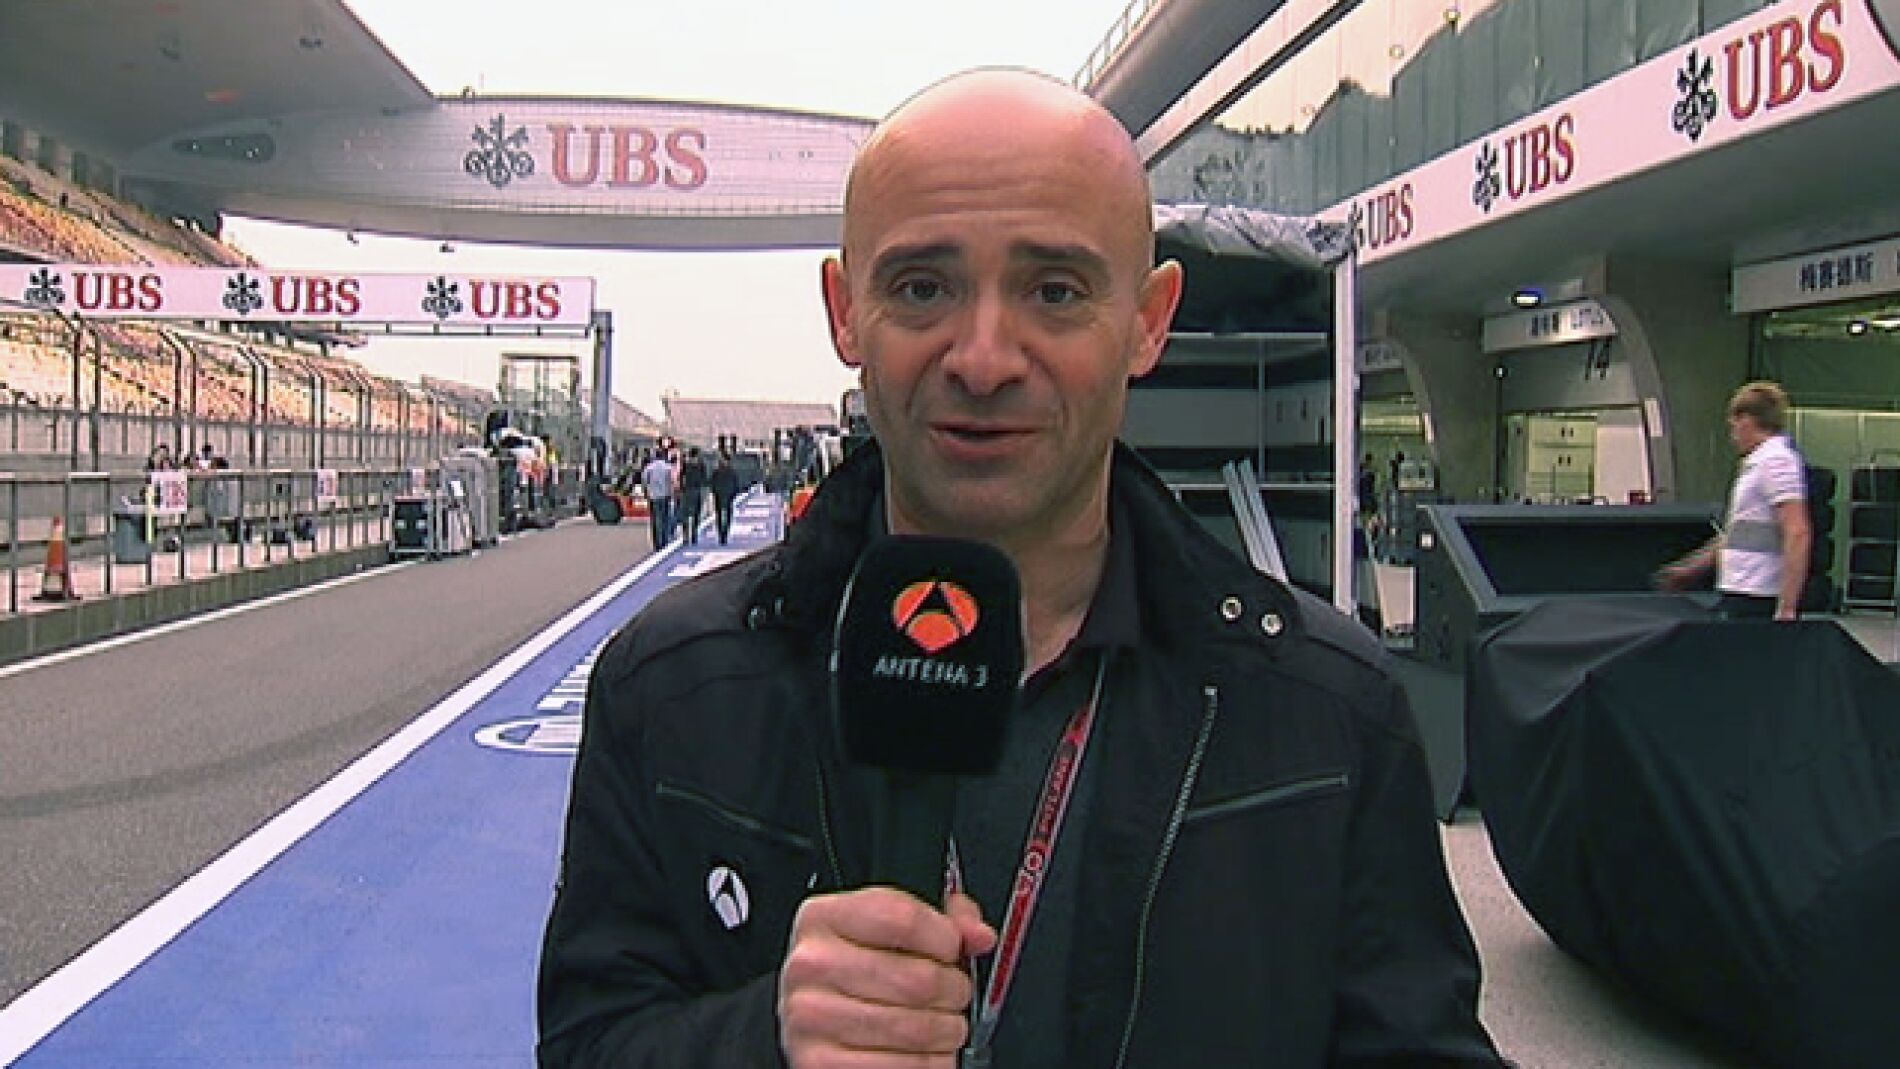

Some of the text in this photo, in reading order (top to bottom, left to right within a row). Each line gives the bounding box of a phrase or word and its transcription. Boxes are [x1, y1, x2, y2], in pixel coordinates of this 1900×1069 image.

[1723, 0, 1846, 120] UBS
[547, 114, 709, 190] UBS
[1504, 113, 1576, 200] UBS
[1367, 182, 1415, 250] UBS
[72, 271, 164, 312] UBS
[270, 276, 363, 316] UBS
[469, 280, 562, 320] UBS
[873, 656, 989, 688] ANTENA 3
